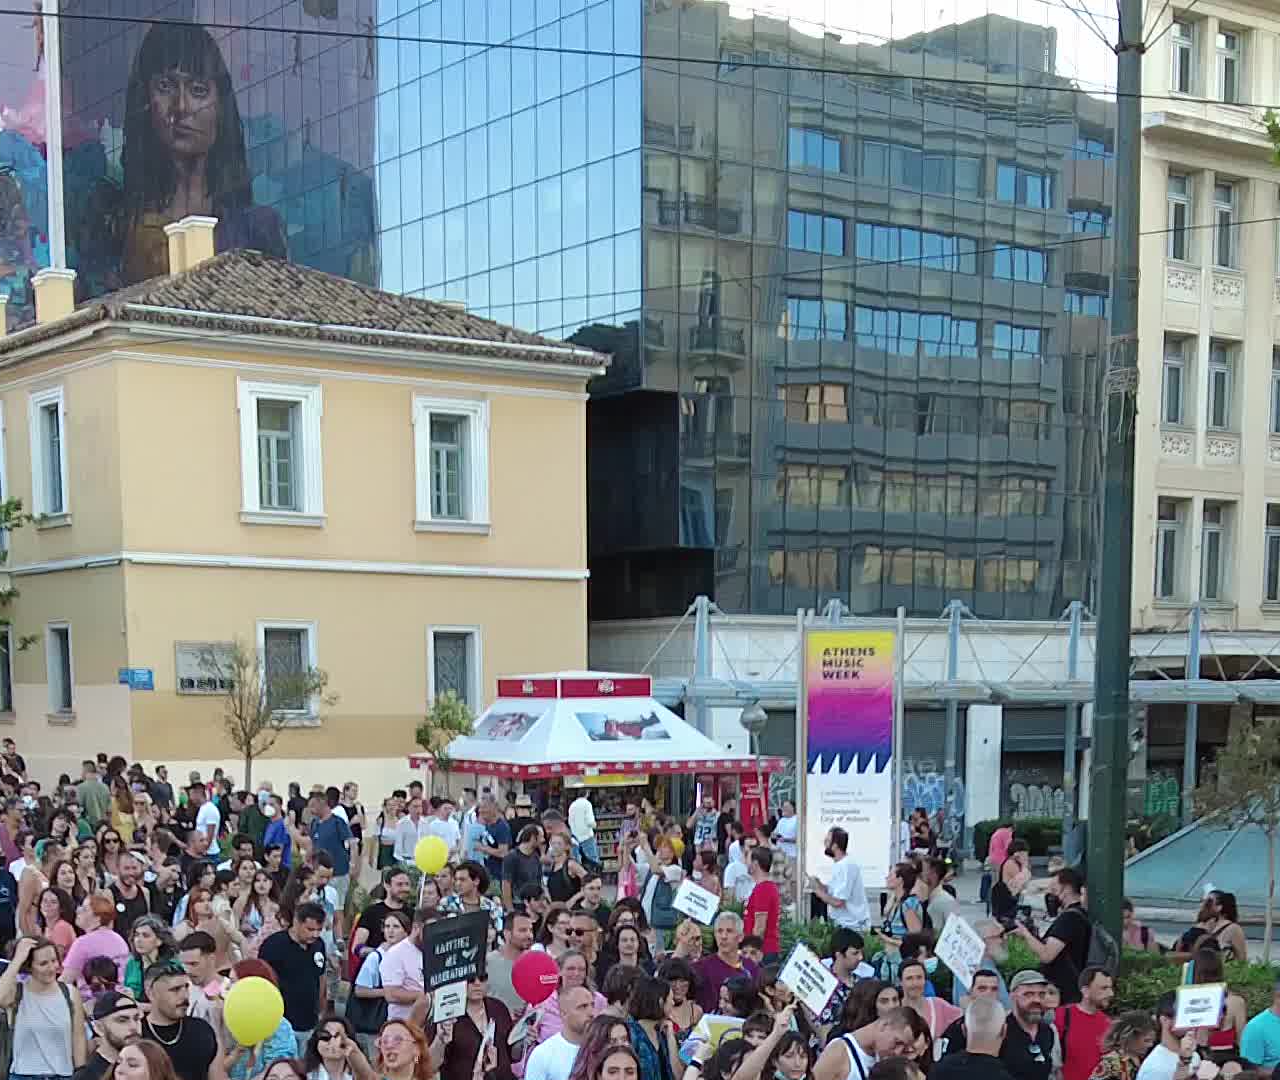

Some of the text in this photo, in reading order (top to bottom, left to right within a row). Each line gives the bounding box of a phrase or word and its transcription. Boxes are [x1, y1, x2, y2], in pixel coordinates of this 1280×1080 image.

[822, 647, 876, 657] ATHENS
[822, 658, 865, 668] MUSIC
[822, 670, 861, 680] WEEK
